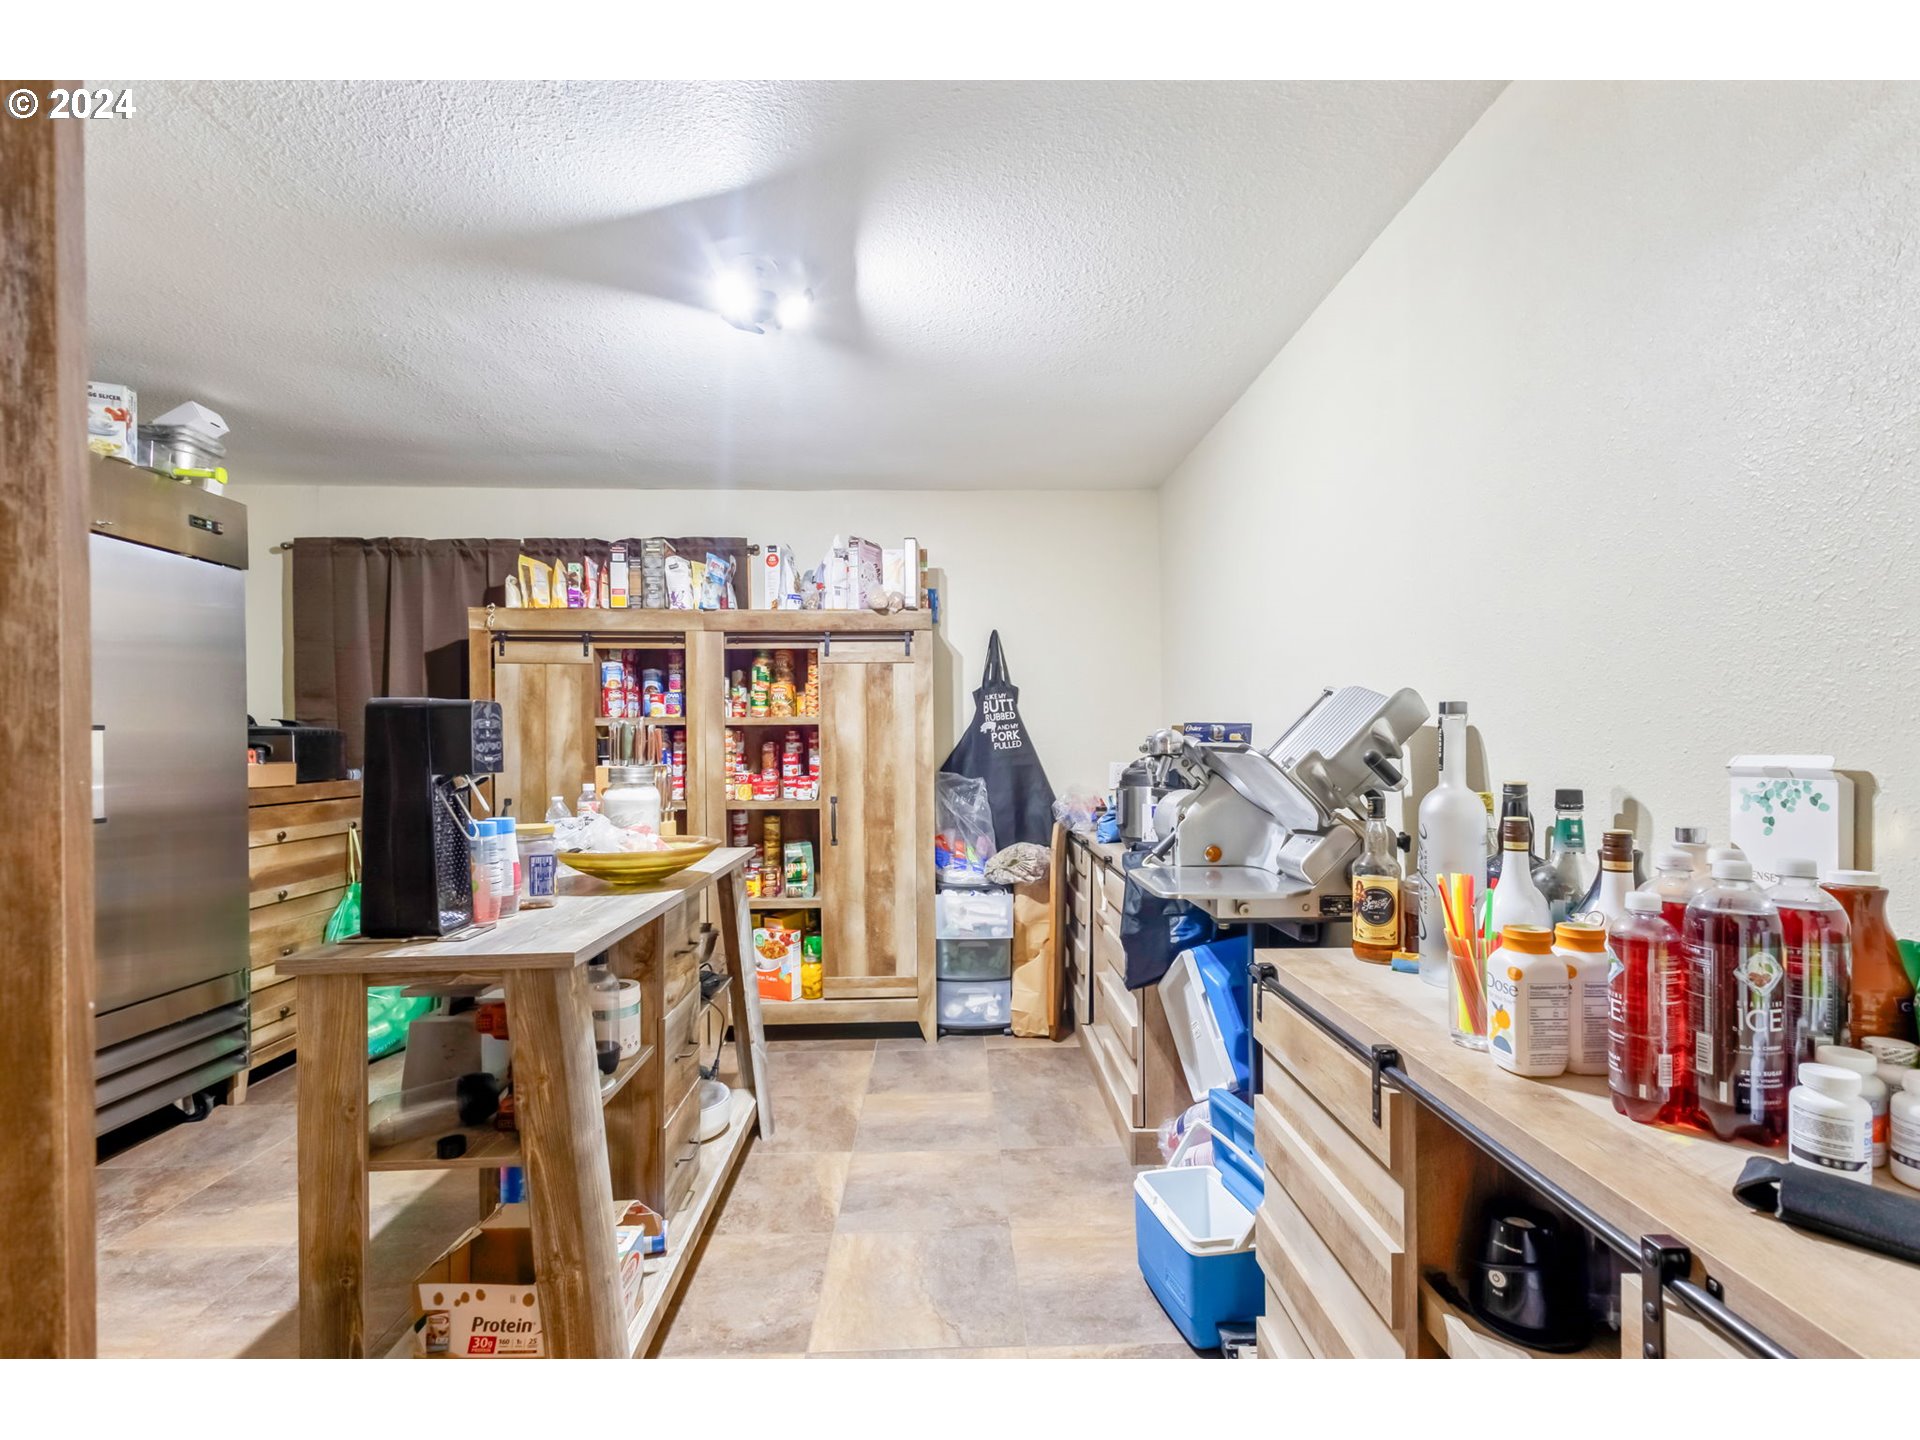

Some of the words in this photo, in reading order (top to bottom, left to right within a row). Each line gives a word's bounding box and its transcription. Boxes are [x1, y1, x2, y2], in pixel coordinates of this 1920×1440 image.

[98, 393, 122, 401] SLICER
[983, 699, 1014, 714] BUTT
[985, 711, 1016, 722] RUBBED
[991, 730, 1020, 742] PORK
[994, 740, 1022, 750] PULLED
[1488, 971, 1519, 997] Dose
[1737, 1008, 1783, 1032] ICE
[471, 1316, 533, 1333] Protein
[472, 1337, 493, 1349] 30g
